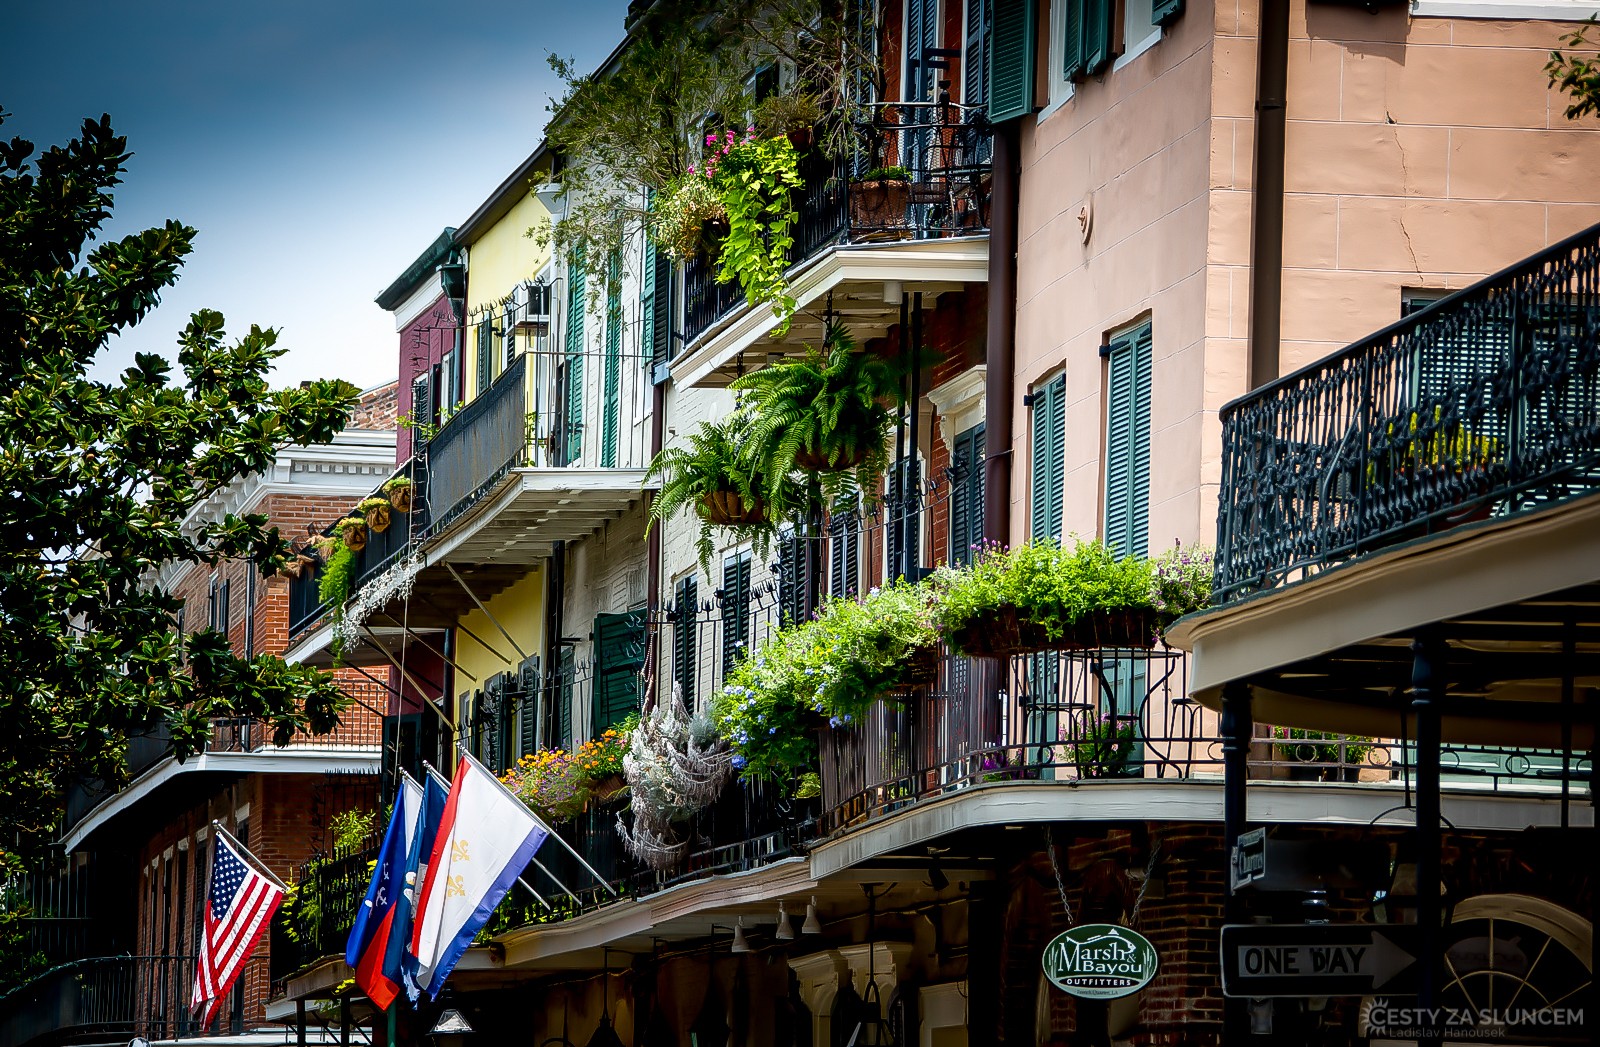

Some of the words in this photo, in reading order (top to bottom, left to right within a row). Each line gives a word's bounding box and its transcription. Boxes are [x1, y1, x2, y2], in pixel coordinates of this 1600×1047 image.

[1058, 942, 1126, 972] Marsh
[1126, 953, 1137, 963] &
[1083, 960, 1142, 975] Bayou
[1244, 947, 1299, 974] ONE
[1066, 978, 1131, 986] OUTFITTERS
